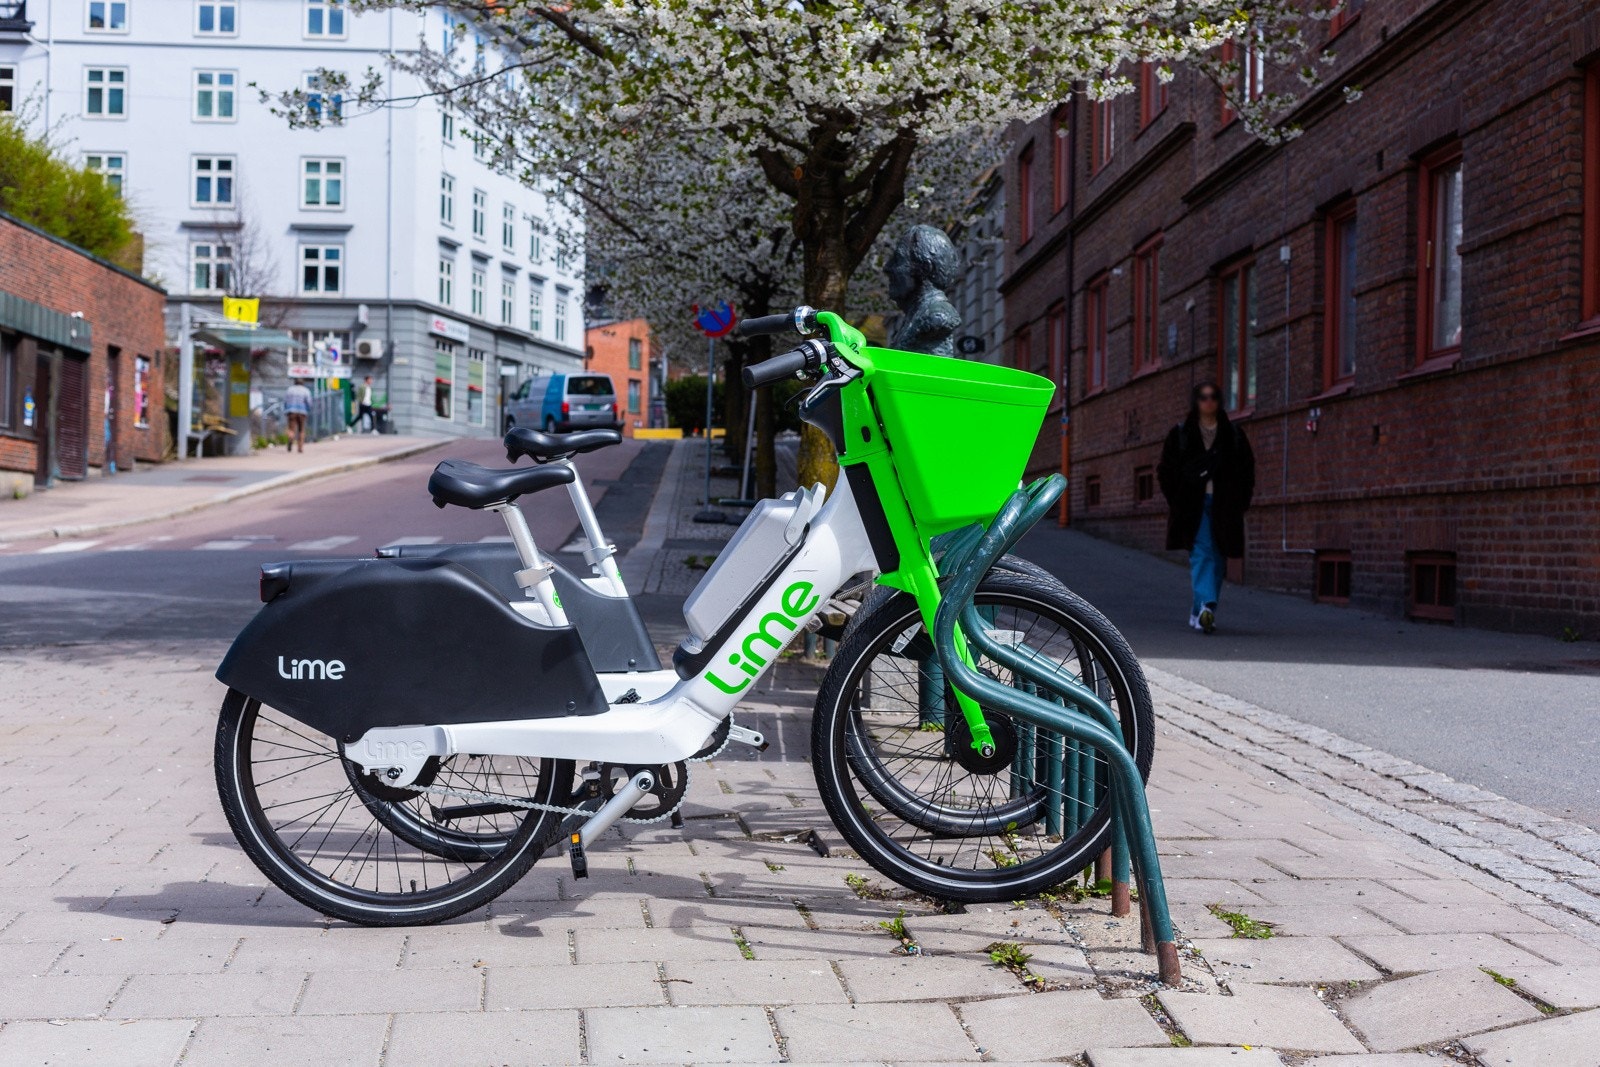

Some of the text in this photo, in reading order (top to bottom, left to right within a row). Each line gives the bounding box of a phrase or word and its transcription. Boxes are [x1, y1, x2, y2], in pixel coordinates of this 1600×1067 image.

[703, 581, 820, 695] Lime
[278, 656, 346, 680] Lime
[364, 739, 428, 760] Lime
